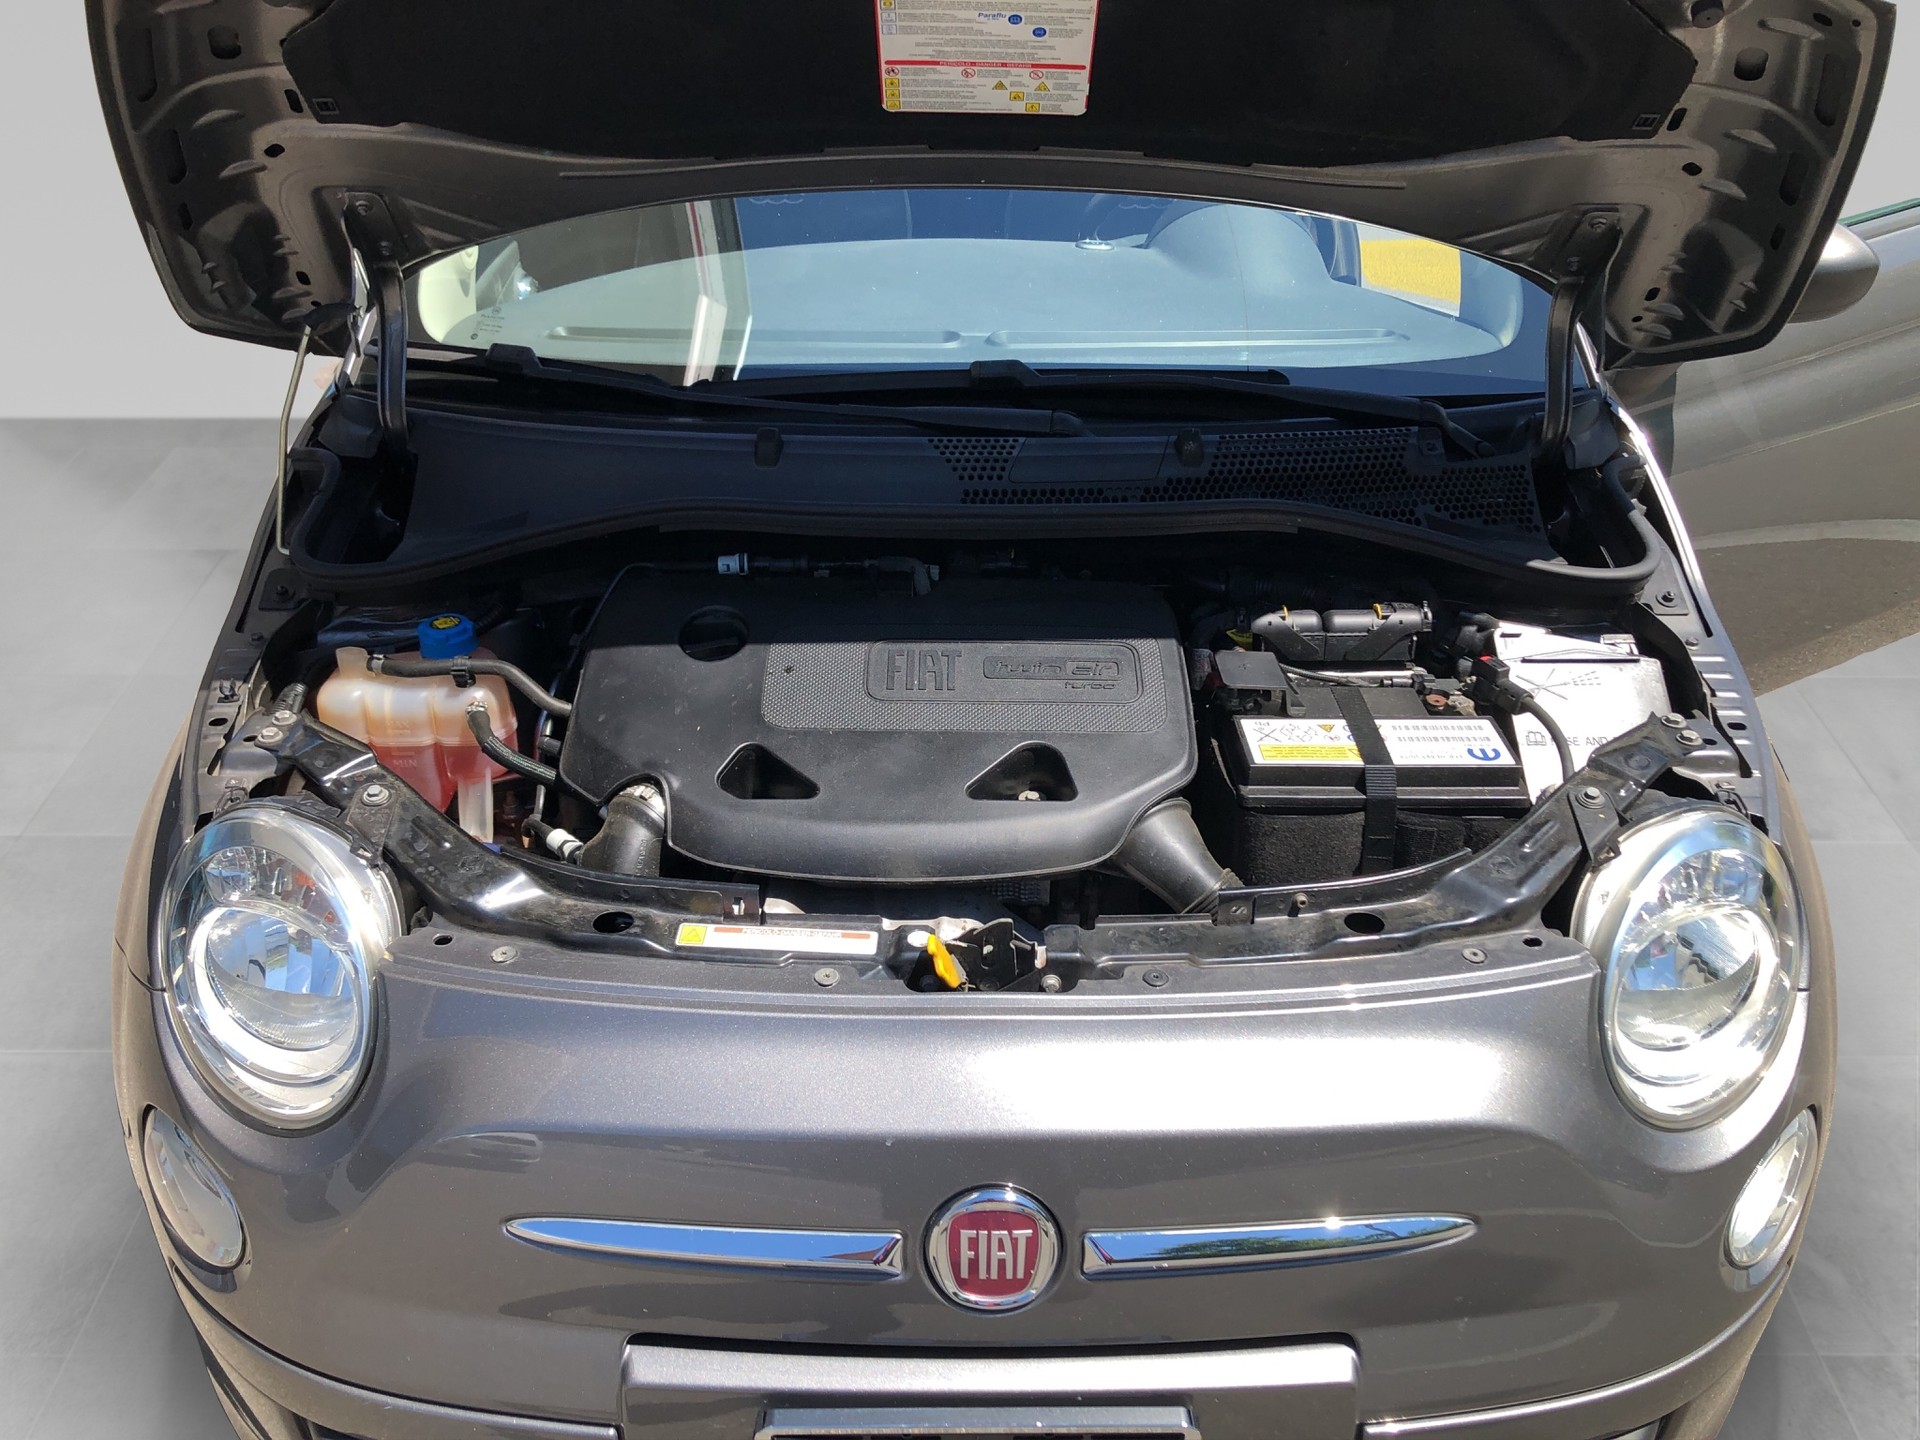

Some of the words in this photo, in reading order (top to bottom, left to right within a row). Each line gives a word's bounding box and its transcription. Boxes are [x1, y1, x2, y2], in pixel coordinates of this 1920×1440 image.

[886, 648, 963, 691] FIAT
[1586, 736, 1608, 746] AND
[959, 1229, 1033, 1280] FIAT
